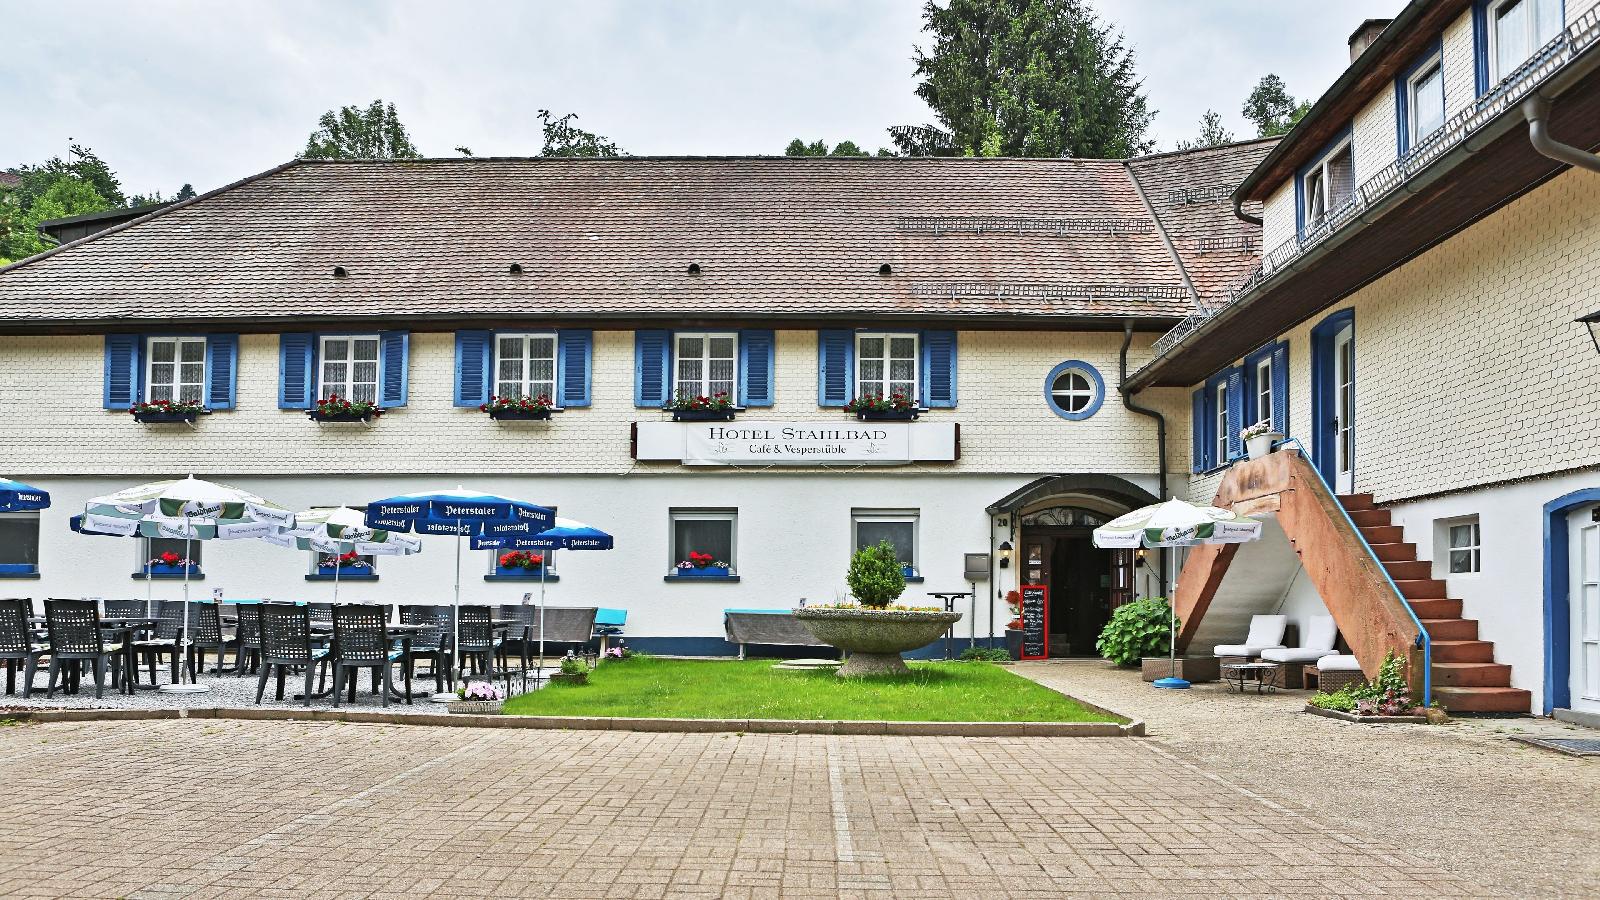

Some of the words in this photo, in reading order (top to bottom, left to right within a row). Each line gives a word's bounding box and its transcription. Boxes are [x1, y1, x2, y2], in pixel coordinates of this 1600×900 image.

[709, 427, 774, 440] HOTEL
[782, 427, 887, 440] STAHLBAD
[749, 444, 771, 454] Café
[773, 445, 782, 454] &
[784, 444, 847, 456] Vesperstüble
[380, 504, 420, 516] Peterstaler
[445, 505, 496, 516] Peterstaler
[997, 518, 1008, 527] 20
